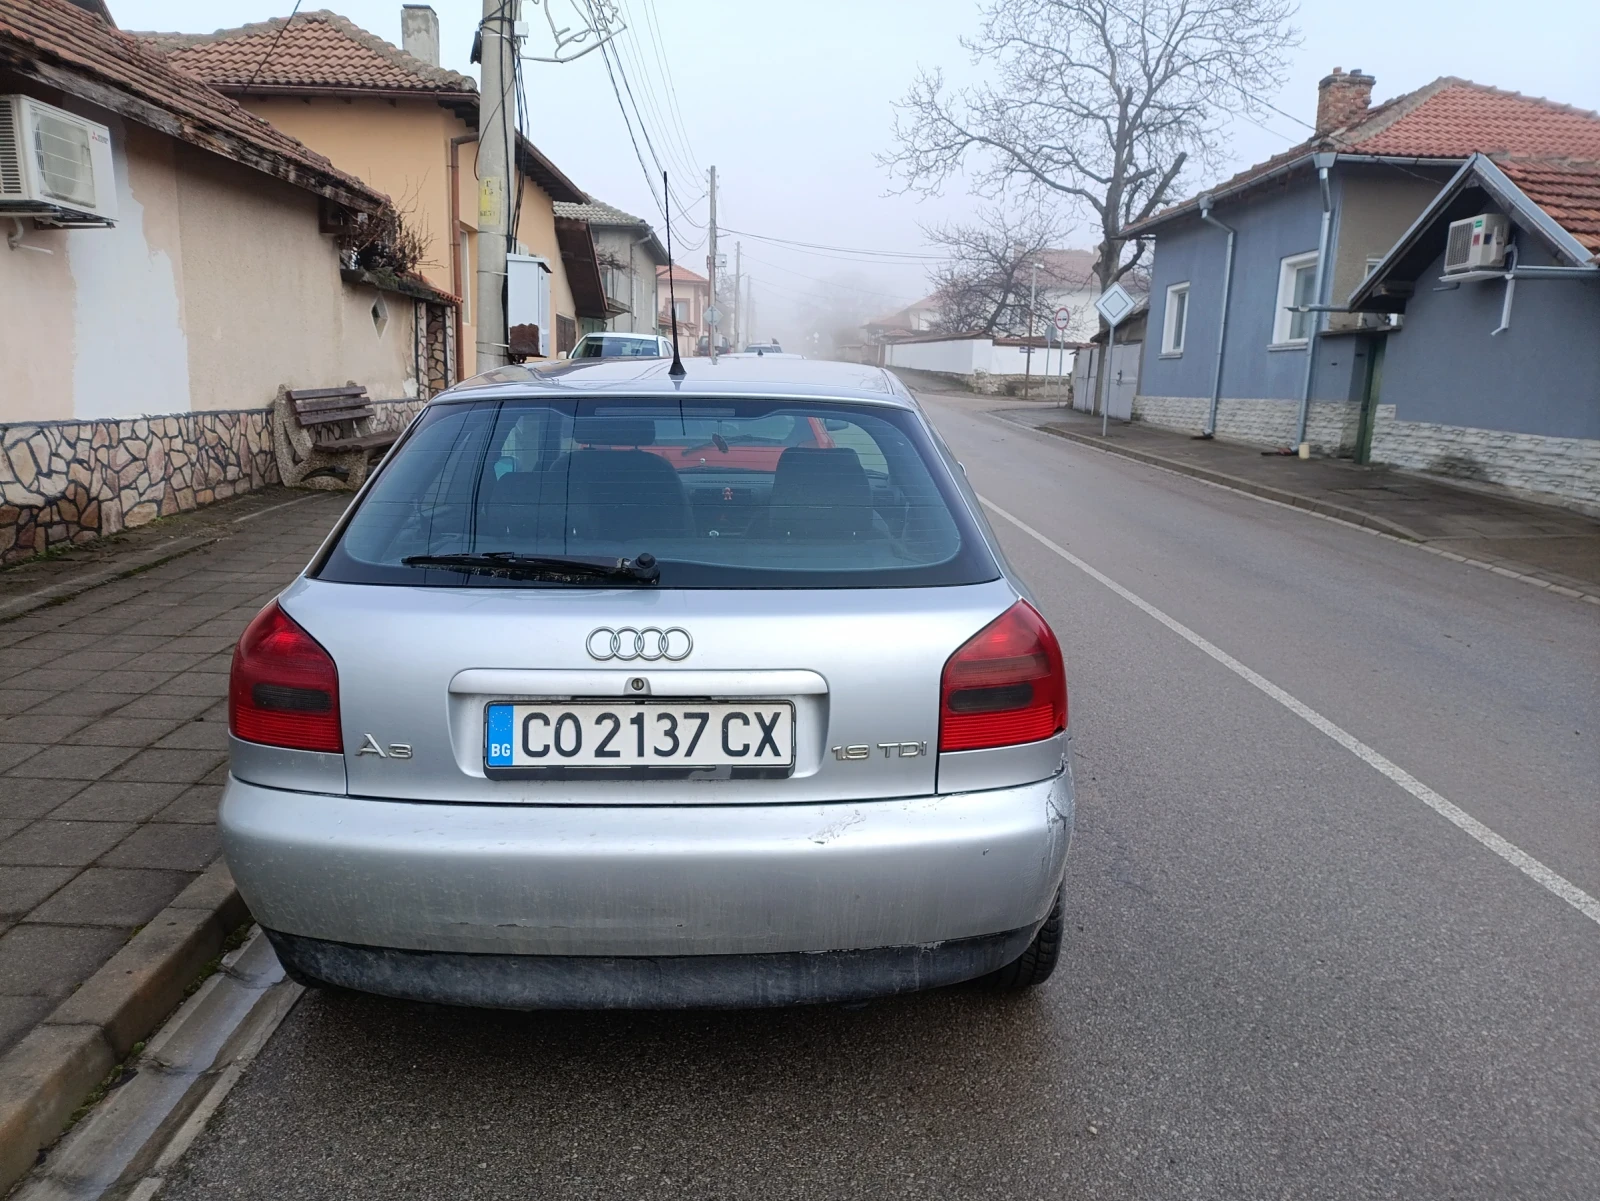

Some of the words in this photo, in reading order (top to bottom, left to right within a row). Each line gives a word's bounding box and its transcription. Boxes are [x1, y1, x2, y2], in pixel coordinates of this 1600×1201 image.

[522, 712, 582, 758] CO
[594, 712, 710, 758] 2137
[721, 712, 782, 757] CX
[355, 733, 413, 759] A3
[491, 743, 511, 757] BG
[832, 743, 870, 760] 1.9
